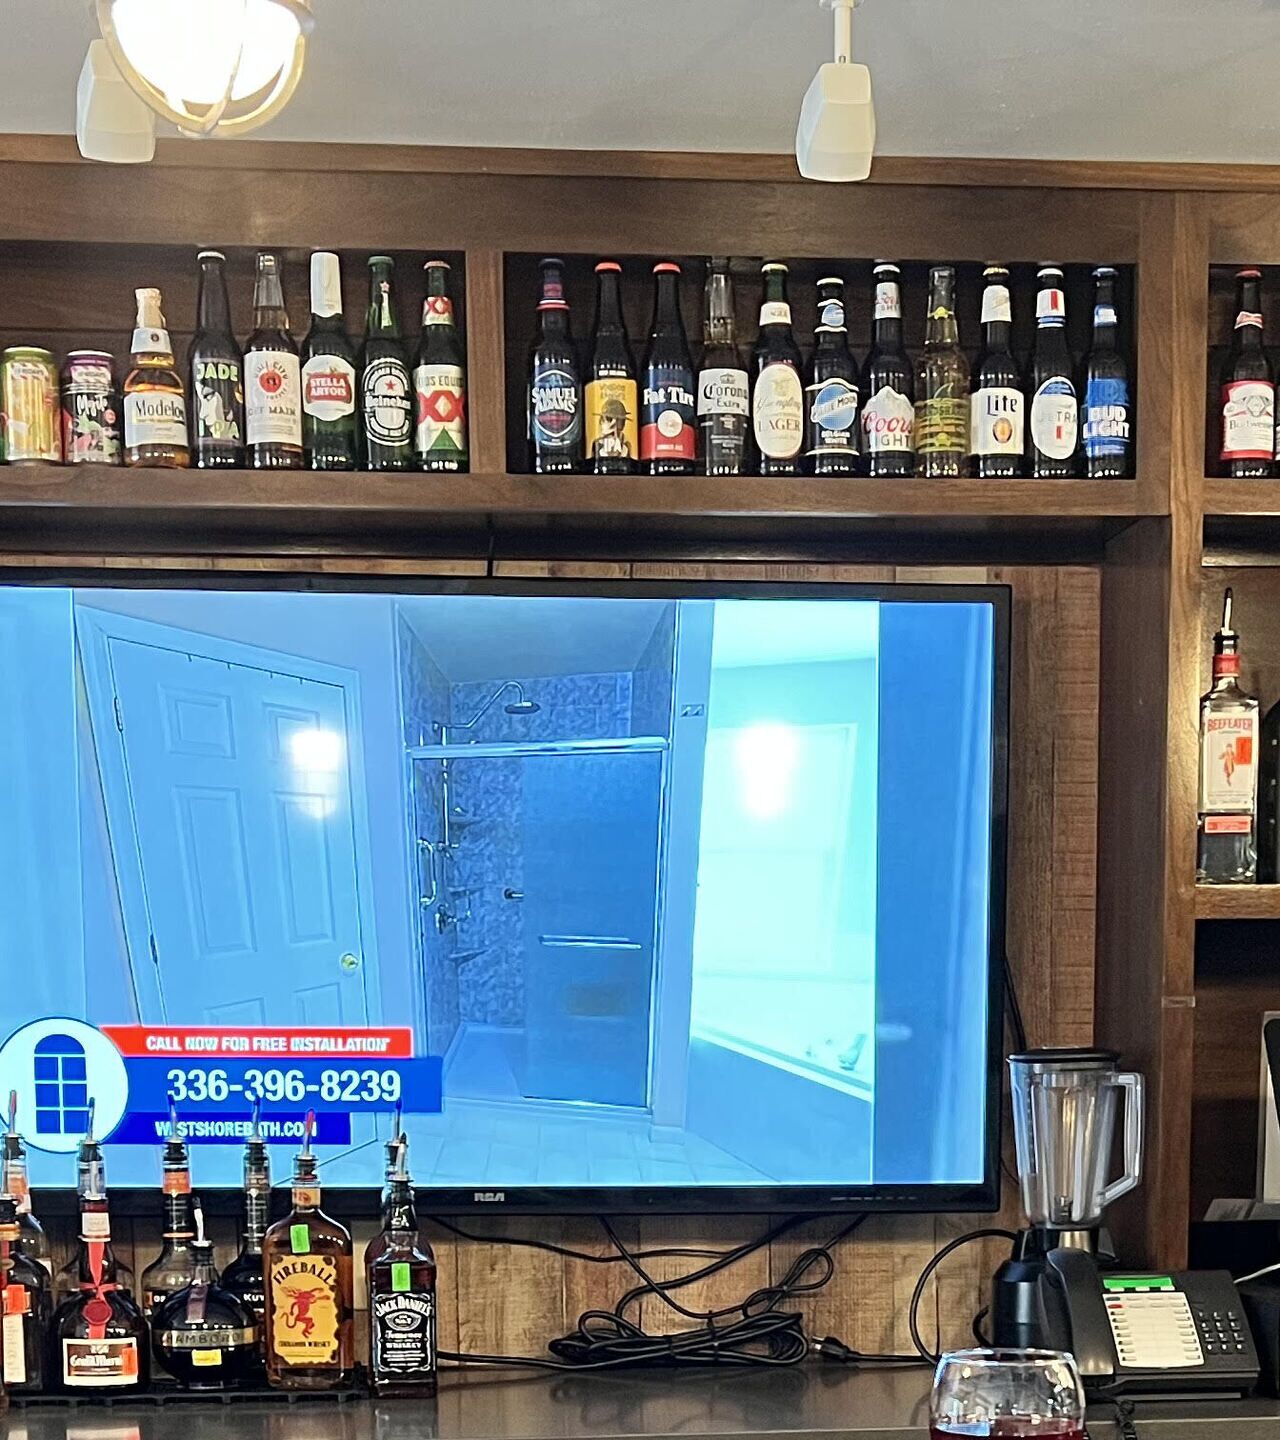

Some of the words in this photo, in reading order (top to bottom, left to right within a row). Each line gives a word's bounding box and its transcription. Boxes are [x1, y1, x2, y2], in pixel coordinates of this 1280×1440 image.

[196, 363, 238, 382] JADE
[310, 378, 346, 388] STELLA
[532, 386, 578, 403] SAMUEL
[643, 387, 666, 405] Fat
[535, 399, 576, 414] ADAMS
[986, 394, 1018, 417] Lite
[1089, 405, 1126, 422] BUD
[1083, 421, 1130, 439] LIGHT
[1207, 718, 1253, 732] BEEFEATER
[146, 1035, 182, 1052] CALL
[184, 1035, 219, 1052] NOW
[221, 1036, 249, 1052] FOR
[252, 1036, 288, 1052] FREE
[167, 1068, 401, 1102] 336-396-8239
[474, 1192, 505, 1202] RCA
[272, 1261, 336, 1286] FIREBALL
[375, 1299, 398, 1317] JACK
[397, 1294, 433, 1315] DANIEL'S
[385, 1341, 422, 1349] WHISKEY
